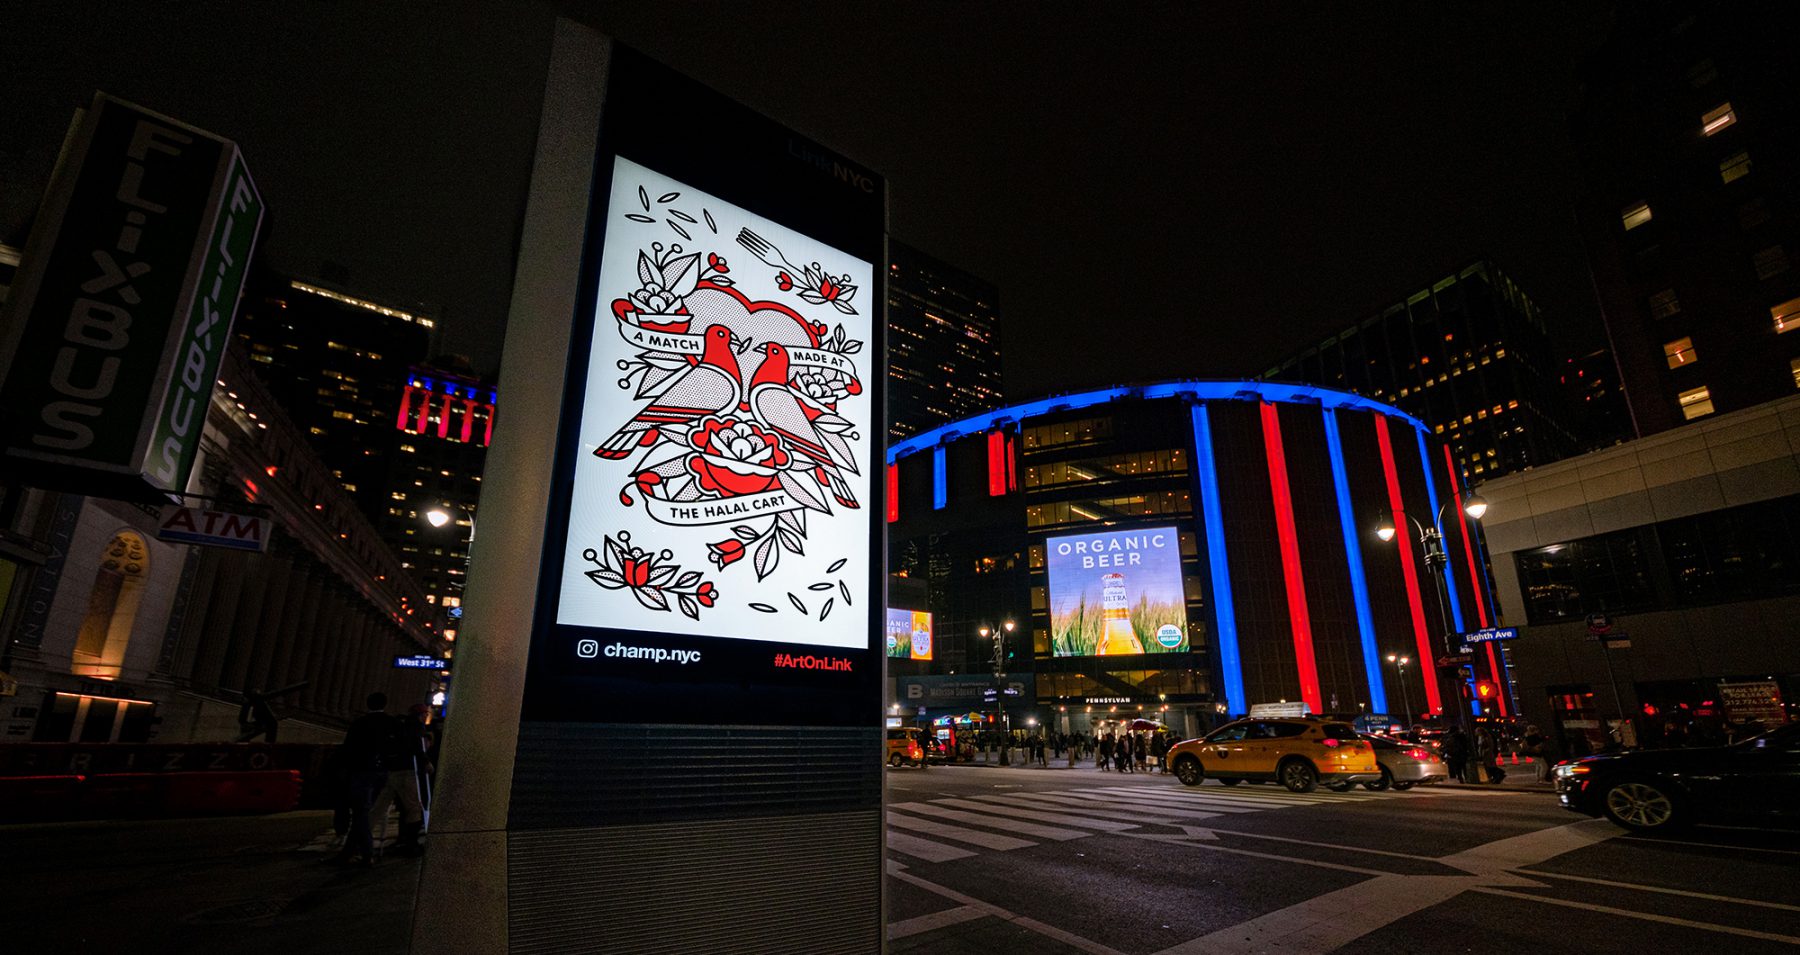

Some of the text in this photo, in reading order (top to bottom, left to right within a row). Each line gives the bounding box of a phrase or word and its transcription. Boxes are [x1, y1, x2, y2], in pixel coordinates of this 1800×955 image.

[786, 138, 875, 193] LinkNYC
[633, 331, 700, 351] A MATCH
[793, 351, 845, 367] MADE AT
[670, 495, 786, 519] THE HALAL CART
[161, 507, 260, 541] ATM
[1057, 534, 1166, 556] ORGANIC
[1082, 551, 1142, 569] BEER
[887, 619, 910, 628] ANIC
[1466, 630, 1513, 643] Eighth Ave
[398, 658, 420, 667] West
[435, 660, 445, 668] St
[603, 642, 853, 672] champ.nyc #ArtOnLink
[907, 684, 923, 699] B
